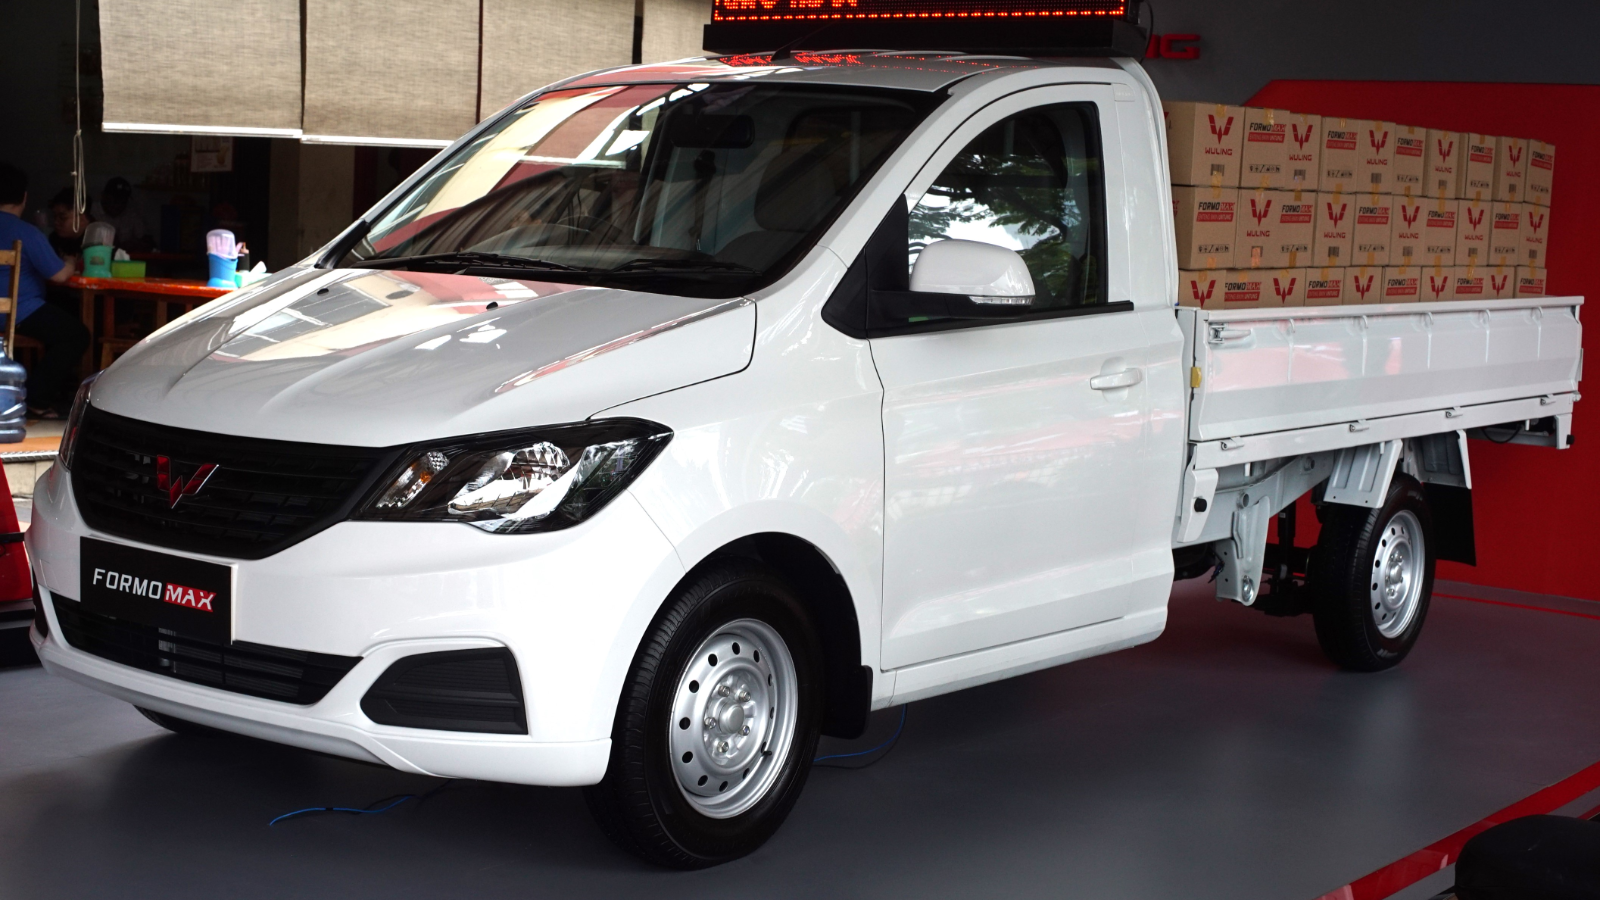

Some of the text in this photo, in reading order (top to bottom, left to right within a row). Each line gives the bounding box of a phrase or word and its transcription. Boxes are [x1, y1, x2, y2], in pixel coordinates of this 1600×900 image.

[1205, 147, 1233, 156] WULING
[1198, 201, 1220, 211] FORMO
[1246, 230, 1271, 238] WULING
[1323, 231, 1346, 239] WULING
[1398, 232, 1419, 240] WULING
[93, 568, 215, 611] FORMO MAX
